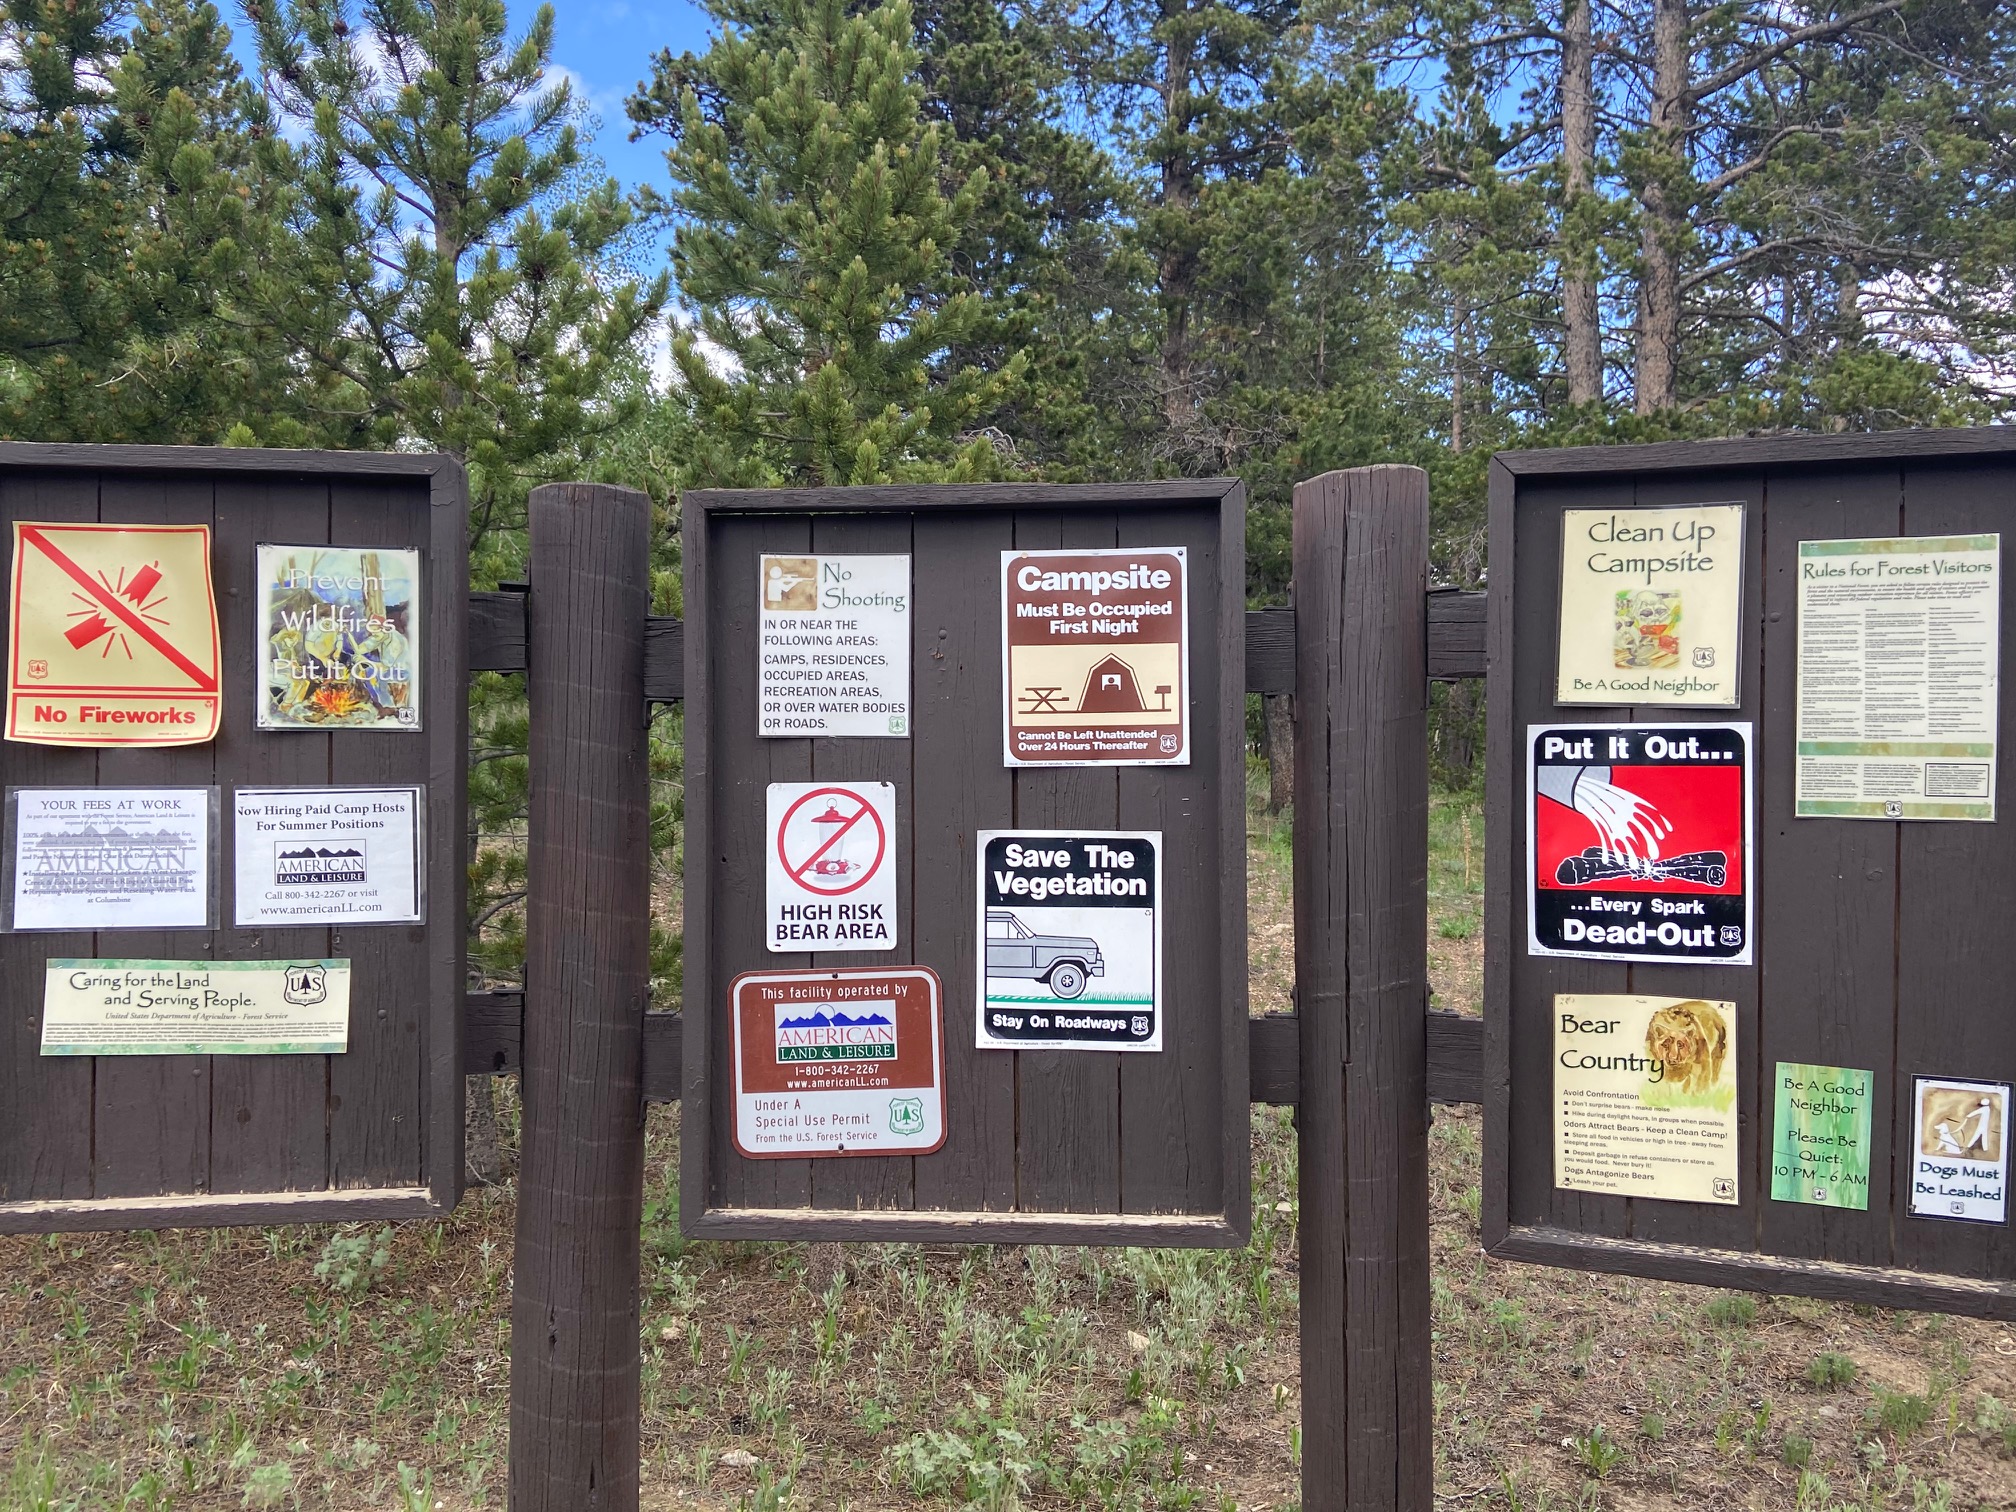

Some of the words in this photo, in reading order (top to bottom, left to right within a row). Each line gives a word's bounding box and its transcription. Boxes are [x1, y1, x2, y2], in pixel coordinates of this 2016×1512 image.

[1589, 515, 1663, 542] Clean
[1673, 521, 1715, 553] Up
[823, 563, 852, 583] No
[1588, 551, 1713, 585] Campsite
[1804, 563, 1846, 579] Rules
[1851, 561, 1874, 576] for
[1878, 560, 1929, 576] Forest
[1933, 560, 1992, 576] Visitors
[289, 569, 390, 590] Prevent
[1017, 564, 1171, 595] Campsite
[823, 588, 905, 612] Shooting
[281, 604, 395, 632] Wildfires
[1017, 604, 1058, 617] Must
[1063, 603, 1086, 616] Be
[1089, 601, 1172, 618] Occupied
[765, 620, 775, 629] IN
[780, 620, 796, 629] OR
[801, 620, 831, 629] NEAR
[835, 620, 857, 629] THE
[1050, 620, 1088, 634] First
[1092, 619, 1138, 636] Night
[765, 636, 832, 645] FOLLOWING
[836, 636, 878, 645] AREAS:
[764, 655, 808, 665] CAMPS,
[813, 656, 888, 666] RESIDENCES,
[273, 659, 320, 679] Put
[323, 661, 345, 679] It
[352, 660, 407, 680] Out
[764, 671, 822, 680] OCCUPIED
[826, 671, 868, 681] AREAS,
[764, 687, 836, 696] RECREATION
[840, 687, 882, 698] AREAS,
[1574, 679, 1592, 689] Be
[1595, 680, 1607, 690] A
[1611, 676, 1649, 690] Good
[1654, 677, 1719, 695] Neighbor
[35, 706, 67, 722] No
[80, 706, 195, 723] Fireworks
[764, 703, 780, 712] OR
[784, 703, 815, 712] OVER
[819, 703, 858, 712] WATER
[863, 703, 905, 712] BODIES
[764, 719, 780, 728] OR
[784, 719, 827, 728] ROADS.
[1018, 732, 1055, 740] Cannot
[1057, 731, 1071, 739] Be
[1074, 730, 1093, 739] Left
[1096, 730, 1157, 739] Unattended
[1019, 743, 1042, 751] Over
[1045, 742, 1057, 751] 24
[1060, 742, 1090, 750] Hours
[1093, 742, 1148, 750] Thereafter
[1545, 737, 1593, 759] Put
[1609, 737, 1629, 759] It
[1645, 736, 1732, 759] Out...
[41, 801, 76, 810] YOUR
[84, 801, 111, 809] FEES
[118, 801, 134, 809] AT
[142, 800, 181, 809] WORK
[265, 806, 302, 817] Hiring
[305, 805, 330, 814] Paid
[334, 804, 369, 816] Camp
[372, 804, 405, 813] Hosts
[257, 821, 276, 830] For
[279, 820, 327, 830] Summer
[331, 819, 384, 829] Positions
[1006, 844, 1071, 867] Save
[1084, 845, 1134, 868] The
[994, 871, 1146, 900] Vegetation
[285, 891, 345, 899] 800-342-2267
[261, 903, 382, 915] www.americanLL.com
[781, 905, 831, 920] HIGH
[839, 904, 883, 919] RISK
[1571, 897, 1641, 915] ...Every
[1651, 899, 1705, 915] Spark
[777, 924, 828, 940] BEAR
[835, 923, 888, 939] AREA
[1563, 919, 1715, 946] Dead-Out
[70, 972, 121, 990] Caring
[126, 972, 147, 986] for
[151, 973, 174, 987] the
[177, 973, 210, 989] Land
[762, 988, 783, 999] This
[790, 986, 832, 999] facility
[838, 985, 888, 997] operated
[895, 984, 908, 996] by
[105, 991, 131, 1005] and
[137, 990, 198, 1009] Serving
[204, 990, 256, 1011] People.
[993, 1014, 1023, 1029] Stay
[1030, 1015, 1049, 1028] On
[1055, 1016, 1126, 1029] Roadways
[1561, 1015, 1620, 1034] Bear
[779, 1027, 893, 1046] AMERICAN
[781, 1048, 817, 1060] LAND
[822, 1048, 833, 1058] &
[839, 1045, 891, 1058] LEISURE
[795, 1065, 879, 1075] 1-800-342-2267
[1560, 1050, 1665, 1083] Country
[787, 1077, 888, 1088] www.americanLL.com
[1784, 1078, 1803, 1090] Be
[1808, 1081, 1819, 1092] A
[1824, 1082, 1865, 1096] Good
[1586, 1090, 1639, 1100] Confrontation
[755, 1100, 788, 1111] Under
[794, 1099, 801, 1109] A
[1790, 1098, 1857, 1116] Neighbor
[756, 1115, 798, 1129] Special
[805, 1115, 825, 1126] Use
[832, 1113, 870, 1125] Permit
[756, 1134, 776, 1143] From
[780, 1133, 792, 1142] the
[797, 1133, 813, 1142] U.S.
[817, 1132, 842, 1141] Forest
[847, 1131, 878, 1140] Service
[1564, 1121, 1586, 1129] Odors
[1588, 1122, 1614, 1130] Attract
[1617, 1124, 1639, 1132] Bears
[1647, 1127, 1667, 1135] Keep
[1677, 1128, 1698, 1136] Clean
[1701, 1130, 1728, 1139] Camp!
[1788, 1128, 1833, 1144] Please
[1837, 1137, 1856, 1147] Be
[1799, 1150, 1843, 1164] Quiet:
[1565, 1166, 1584, 1174] Dogs
[1586, 1169, 1629, 1179] Antagonize
[1632, 1172, 1654, 1180] Bears
[1775, 1166, 1788, 1176] 10
[1793, 1168, 1814, 1180] PM
[1831, 1172, 1837, 1182] 6
[1843, 1173, 1866, 1185] AM
[1920, 1162, 1958, 1179] Dogs
[1963, 1166, 1999, 1179] Must
[1916, 1182, 1935, 1193] Be
[1939, 1184, 2001, 1200] Leashed
